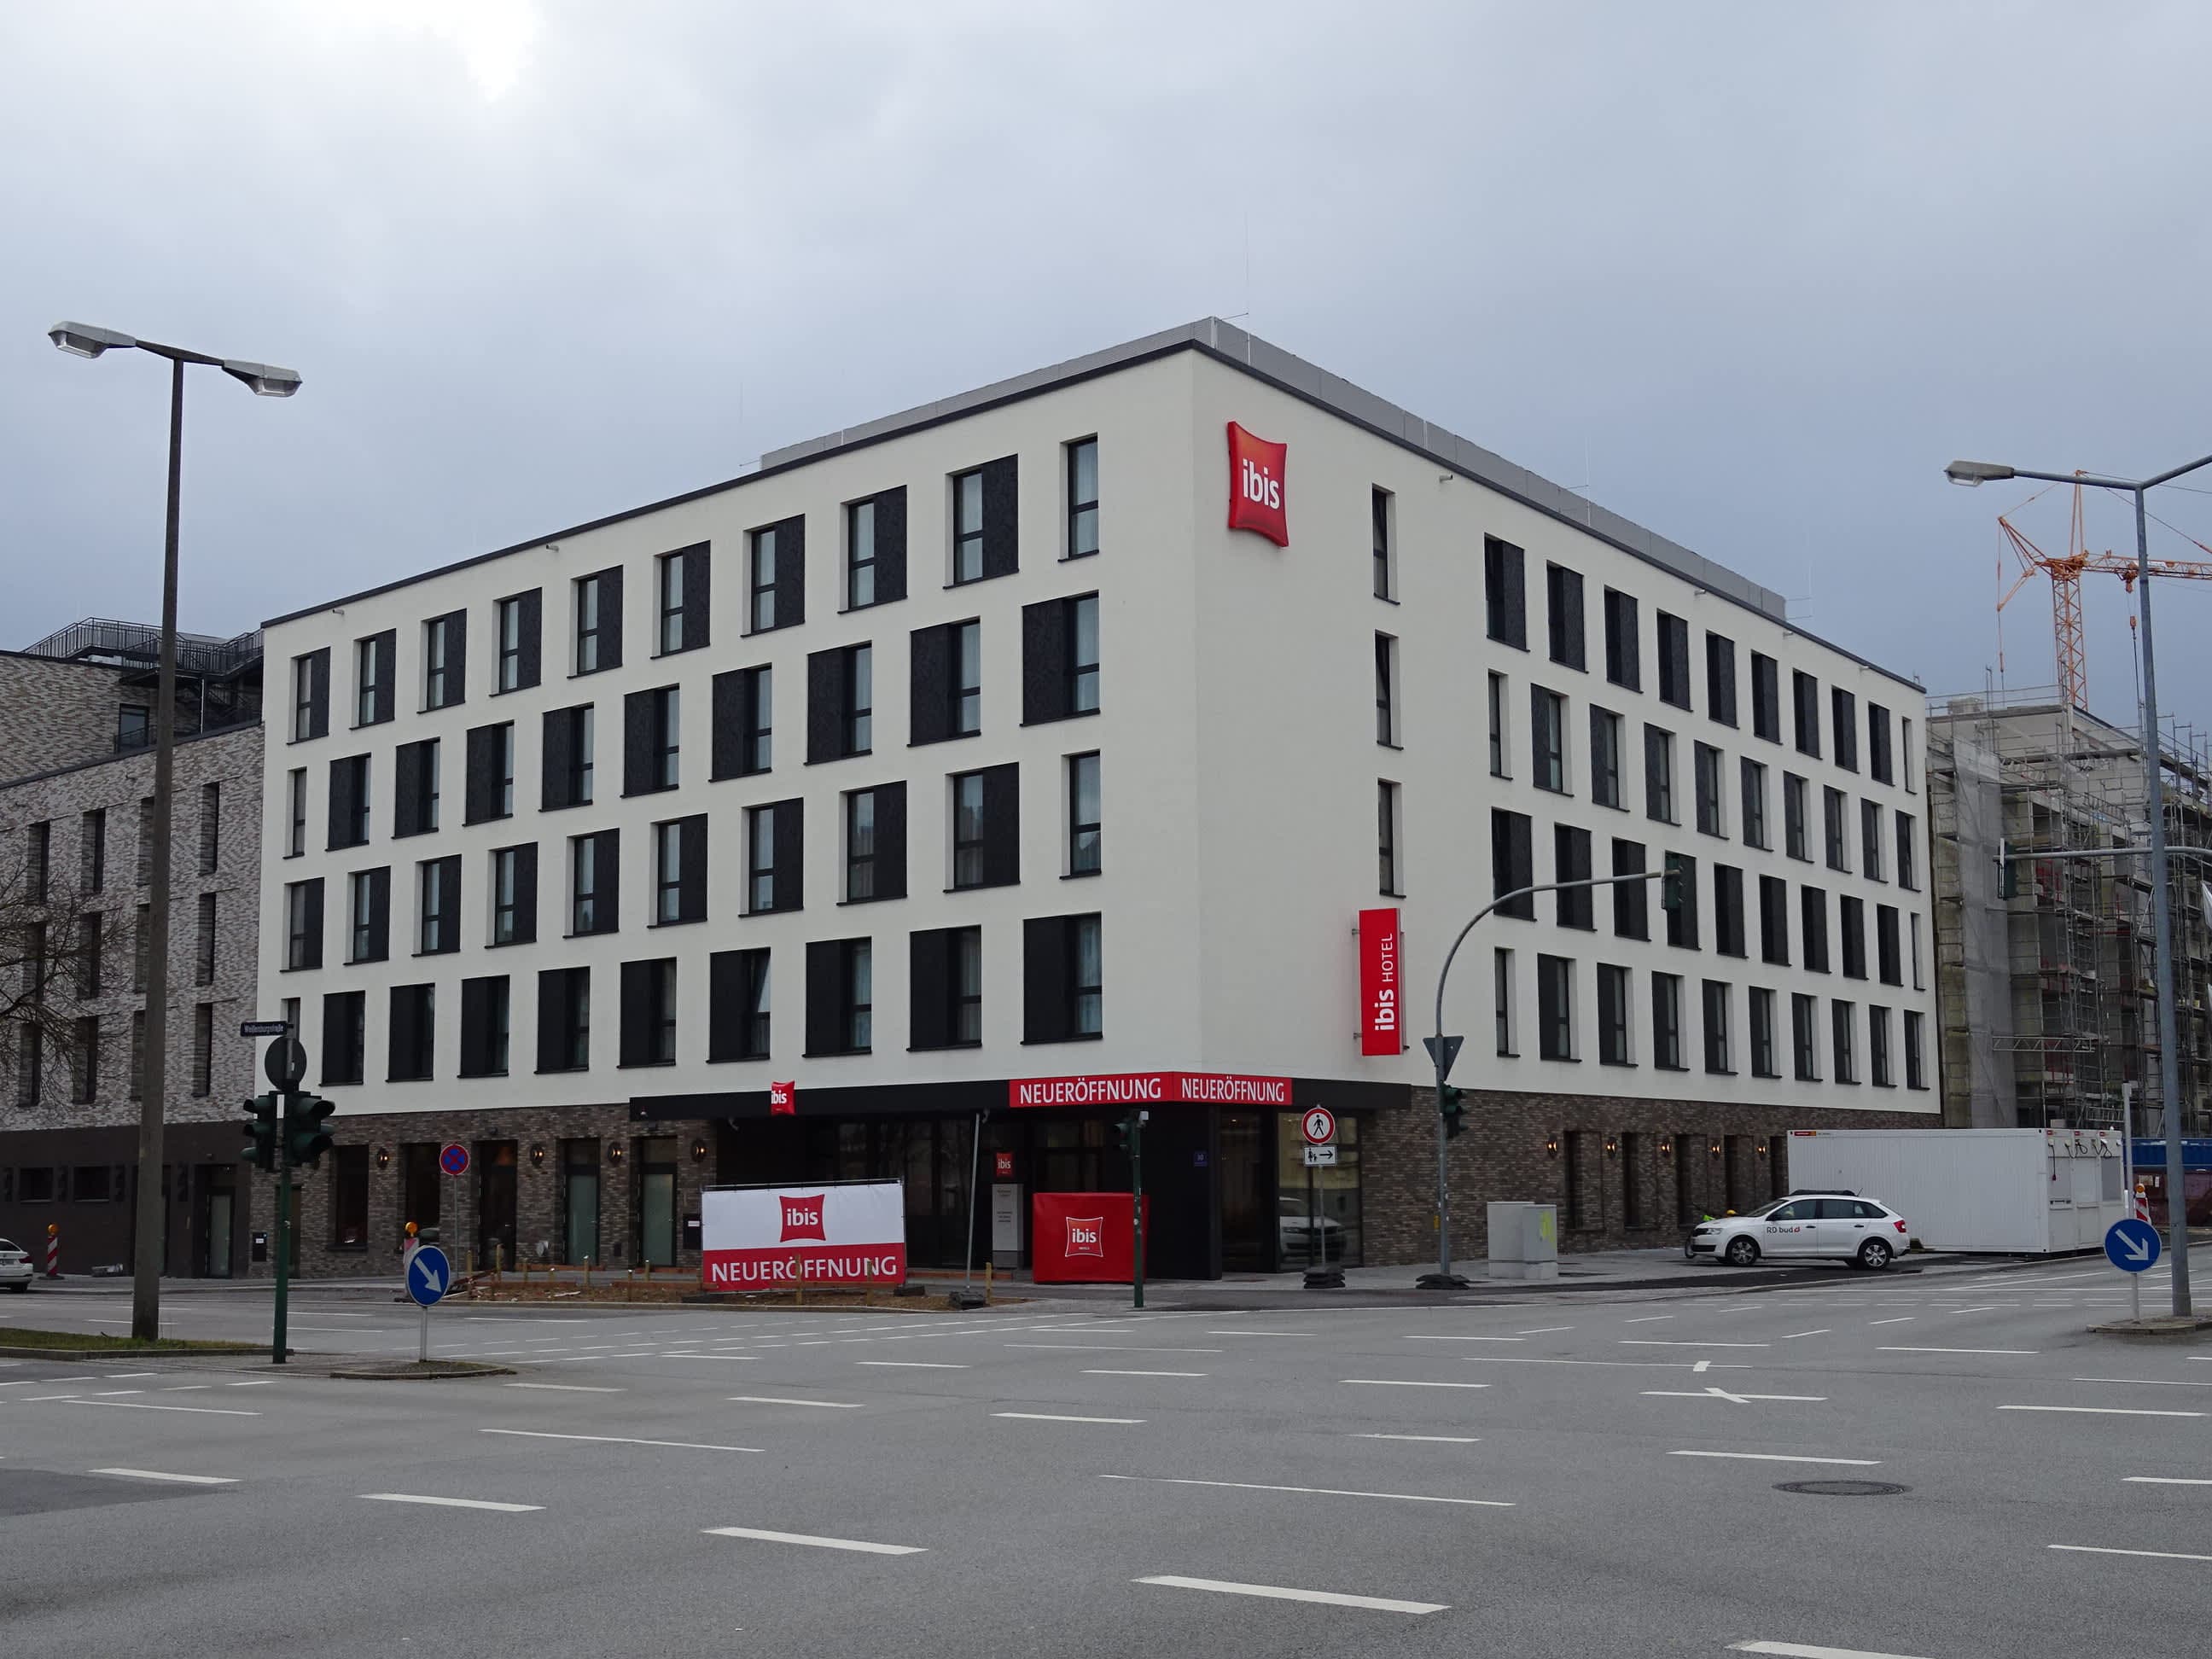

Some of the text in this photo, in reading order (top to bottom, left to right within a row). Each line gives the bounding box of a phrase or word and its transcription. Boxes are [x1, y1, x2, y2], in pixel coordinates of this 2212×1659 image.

[1243, 458, 1280, 509] ibis
[1375, 933, 1395, 1031] ibis HOTEL
[771, 1089, 787, 1104] ibis
[1020, 1077, 1161, 1104] NEUERÖFFNUNG
[1182, 1075, 1284, 1102] NEUERÖFFNUNG
[998, 1158, 1011, 1169] ibis
[787, 1208, 818, 1226] ibis
[1072, 1228, 1097, 1243] ibis
[712, 1255, 897, 1283] NEUERÖFFNUNG
